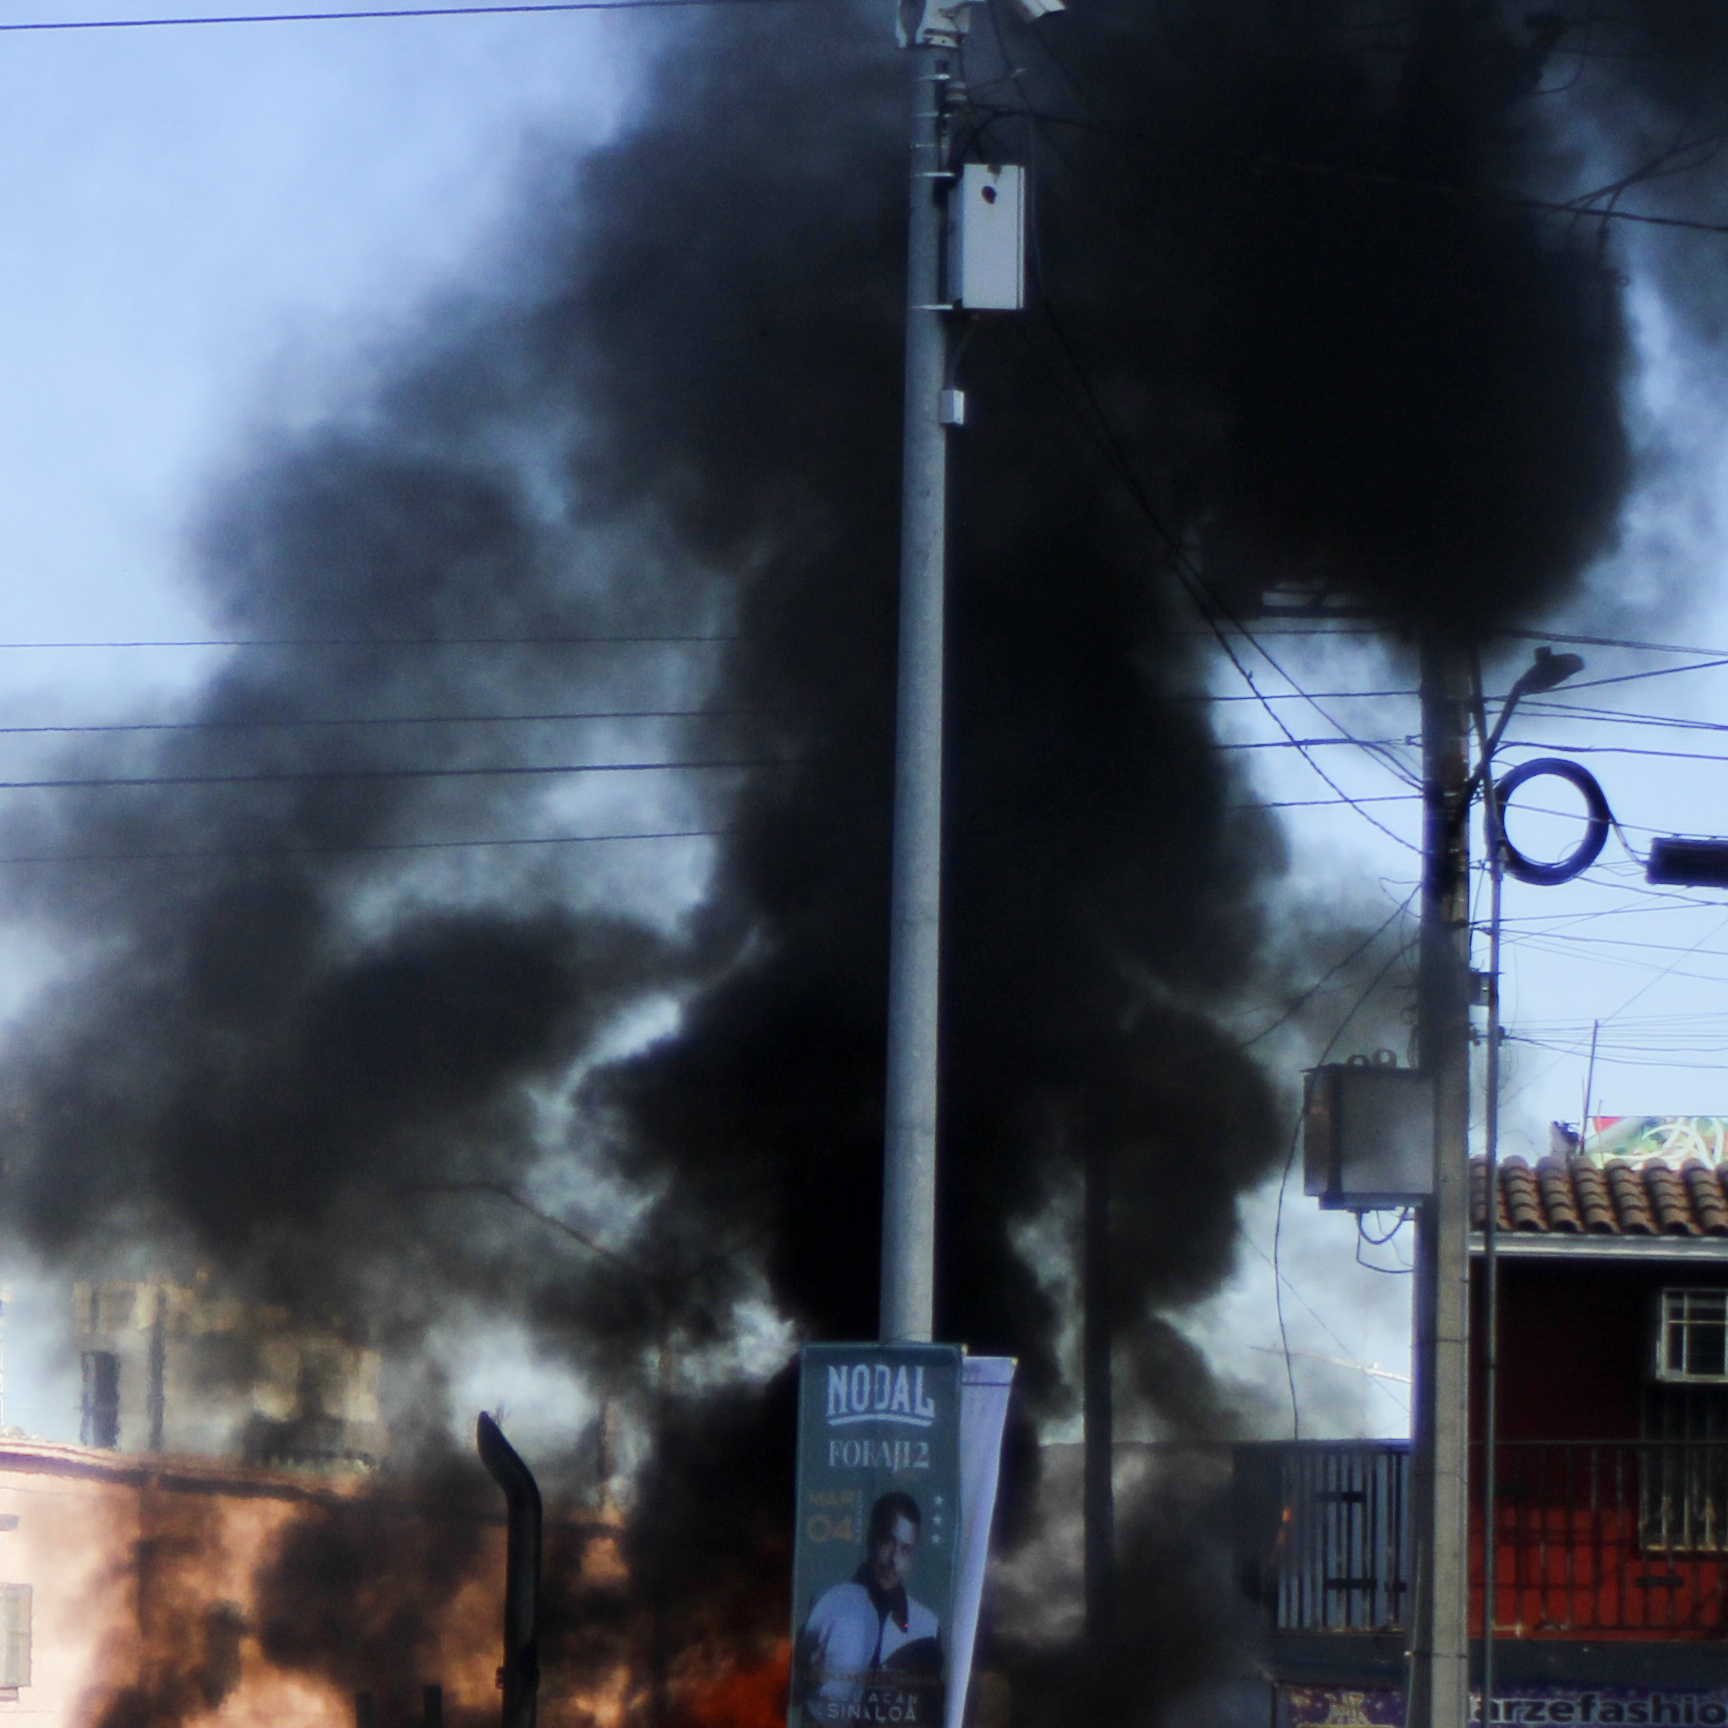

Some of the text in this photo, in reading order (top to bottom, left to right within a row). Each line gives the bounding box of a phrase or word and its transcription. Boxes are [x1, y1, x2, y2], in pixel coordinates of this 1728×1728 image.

[826, 1364, 936, 1419] NODAL
[806, 1513, 854, 1542] 04
[828, 1702, 917, 1722] SINALOA
[1471, 1693, 1728, 1726] arzefashio
